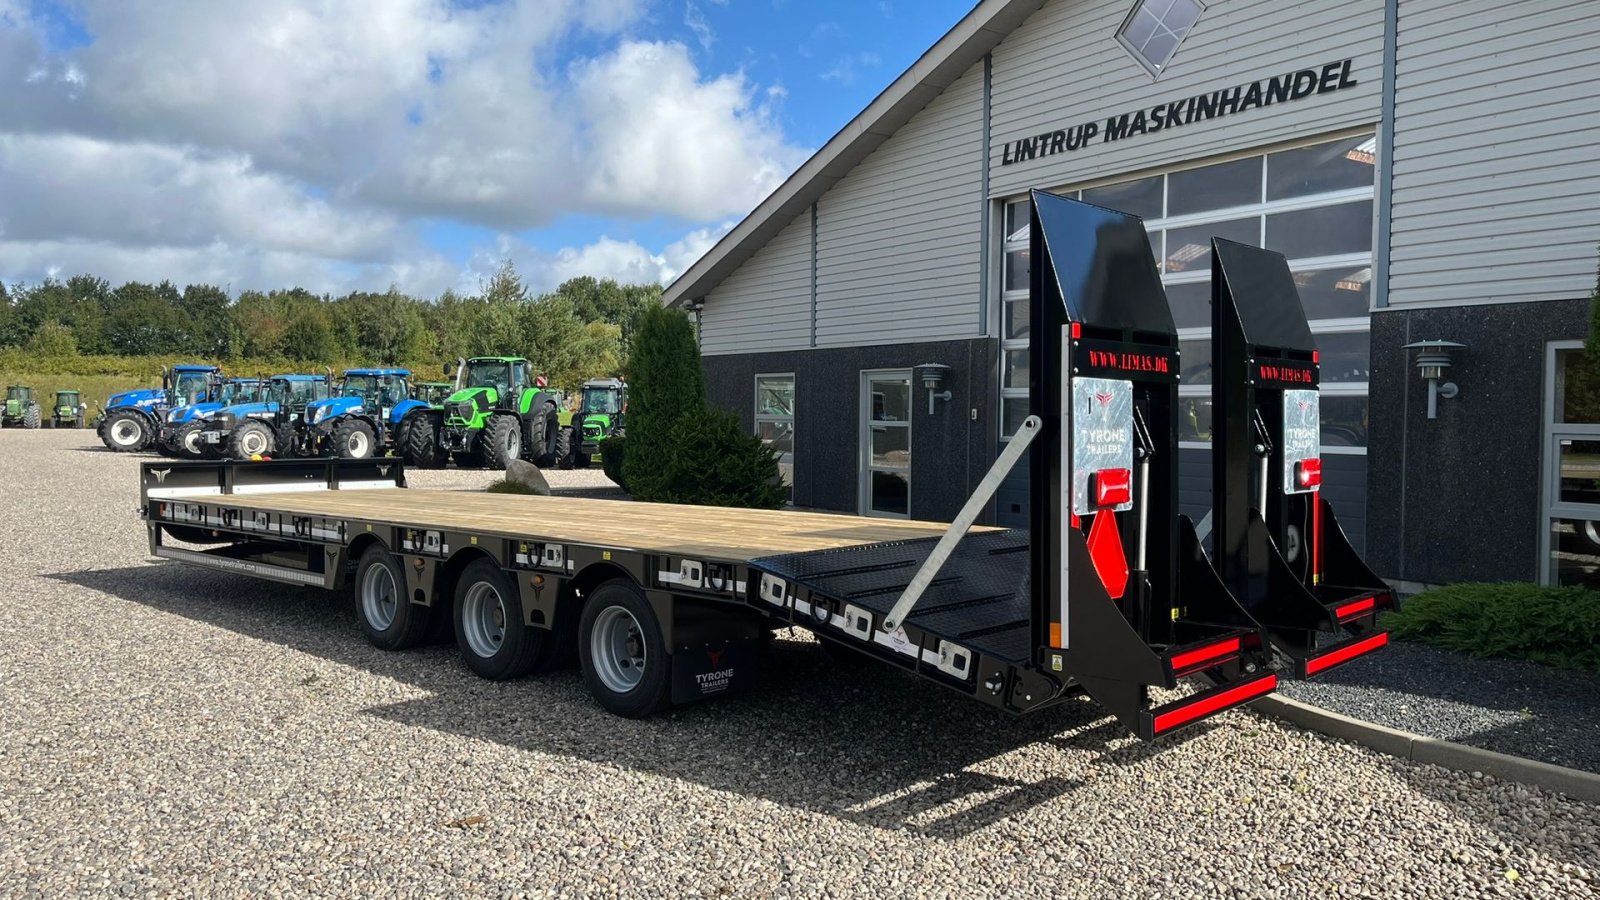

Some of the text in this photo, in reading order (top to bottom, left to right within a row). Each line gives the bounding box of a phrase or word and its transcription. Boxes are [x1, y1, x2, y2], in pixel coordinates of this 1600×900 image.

[1002, 59, 1358, 166] LINTRUP MASKINHANDEL
[1089, 350, 1168, 373] WWW.LIMAS.DK
[1080, 428, 1126, 443] TYRONE
[1288, 428, 1316, 439] TYRONE
[1086, 443, 1123, 455] TRAILERS
[696, 669, 734, 683] TYRONE
[701, 678, 728, 688] TRAILERS
